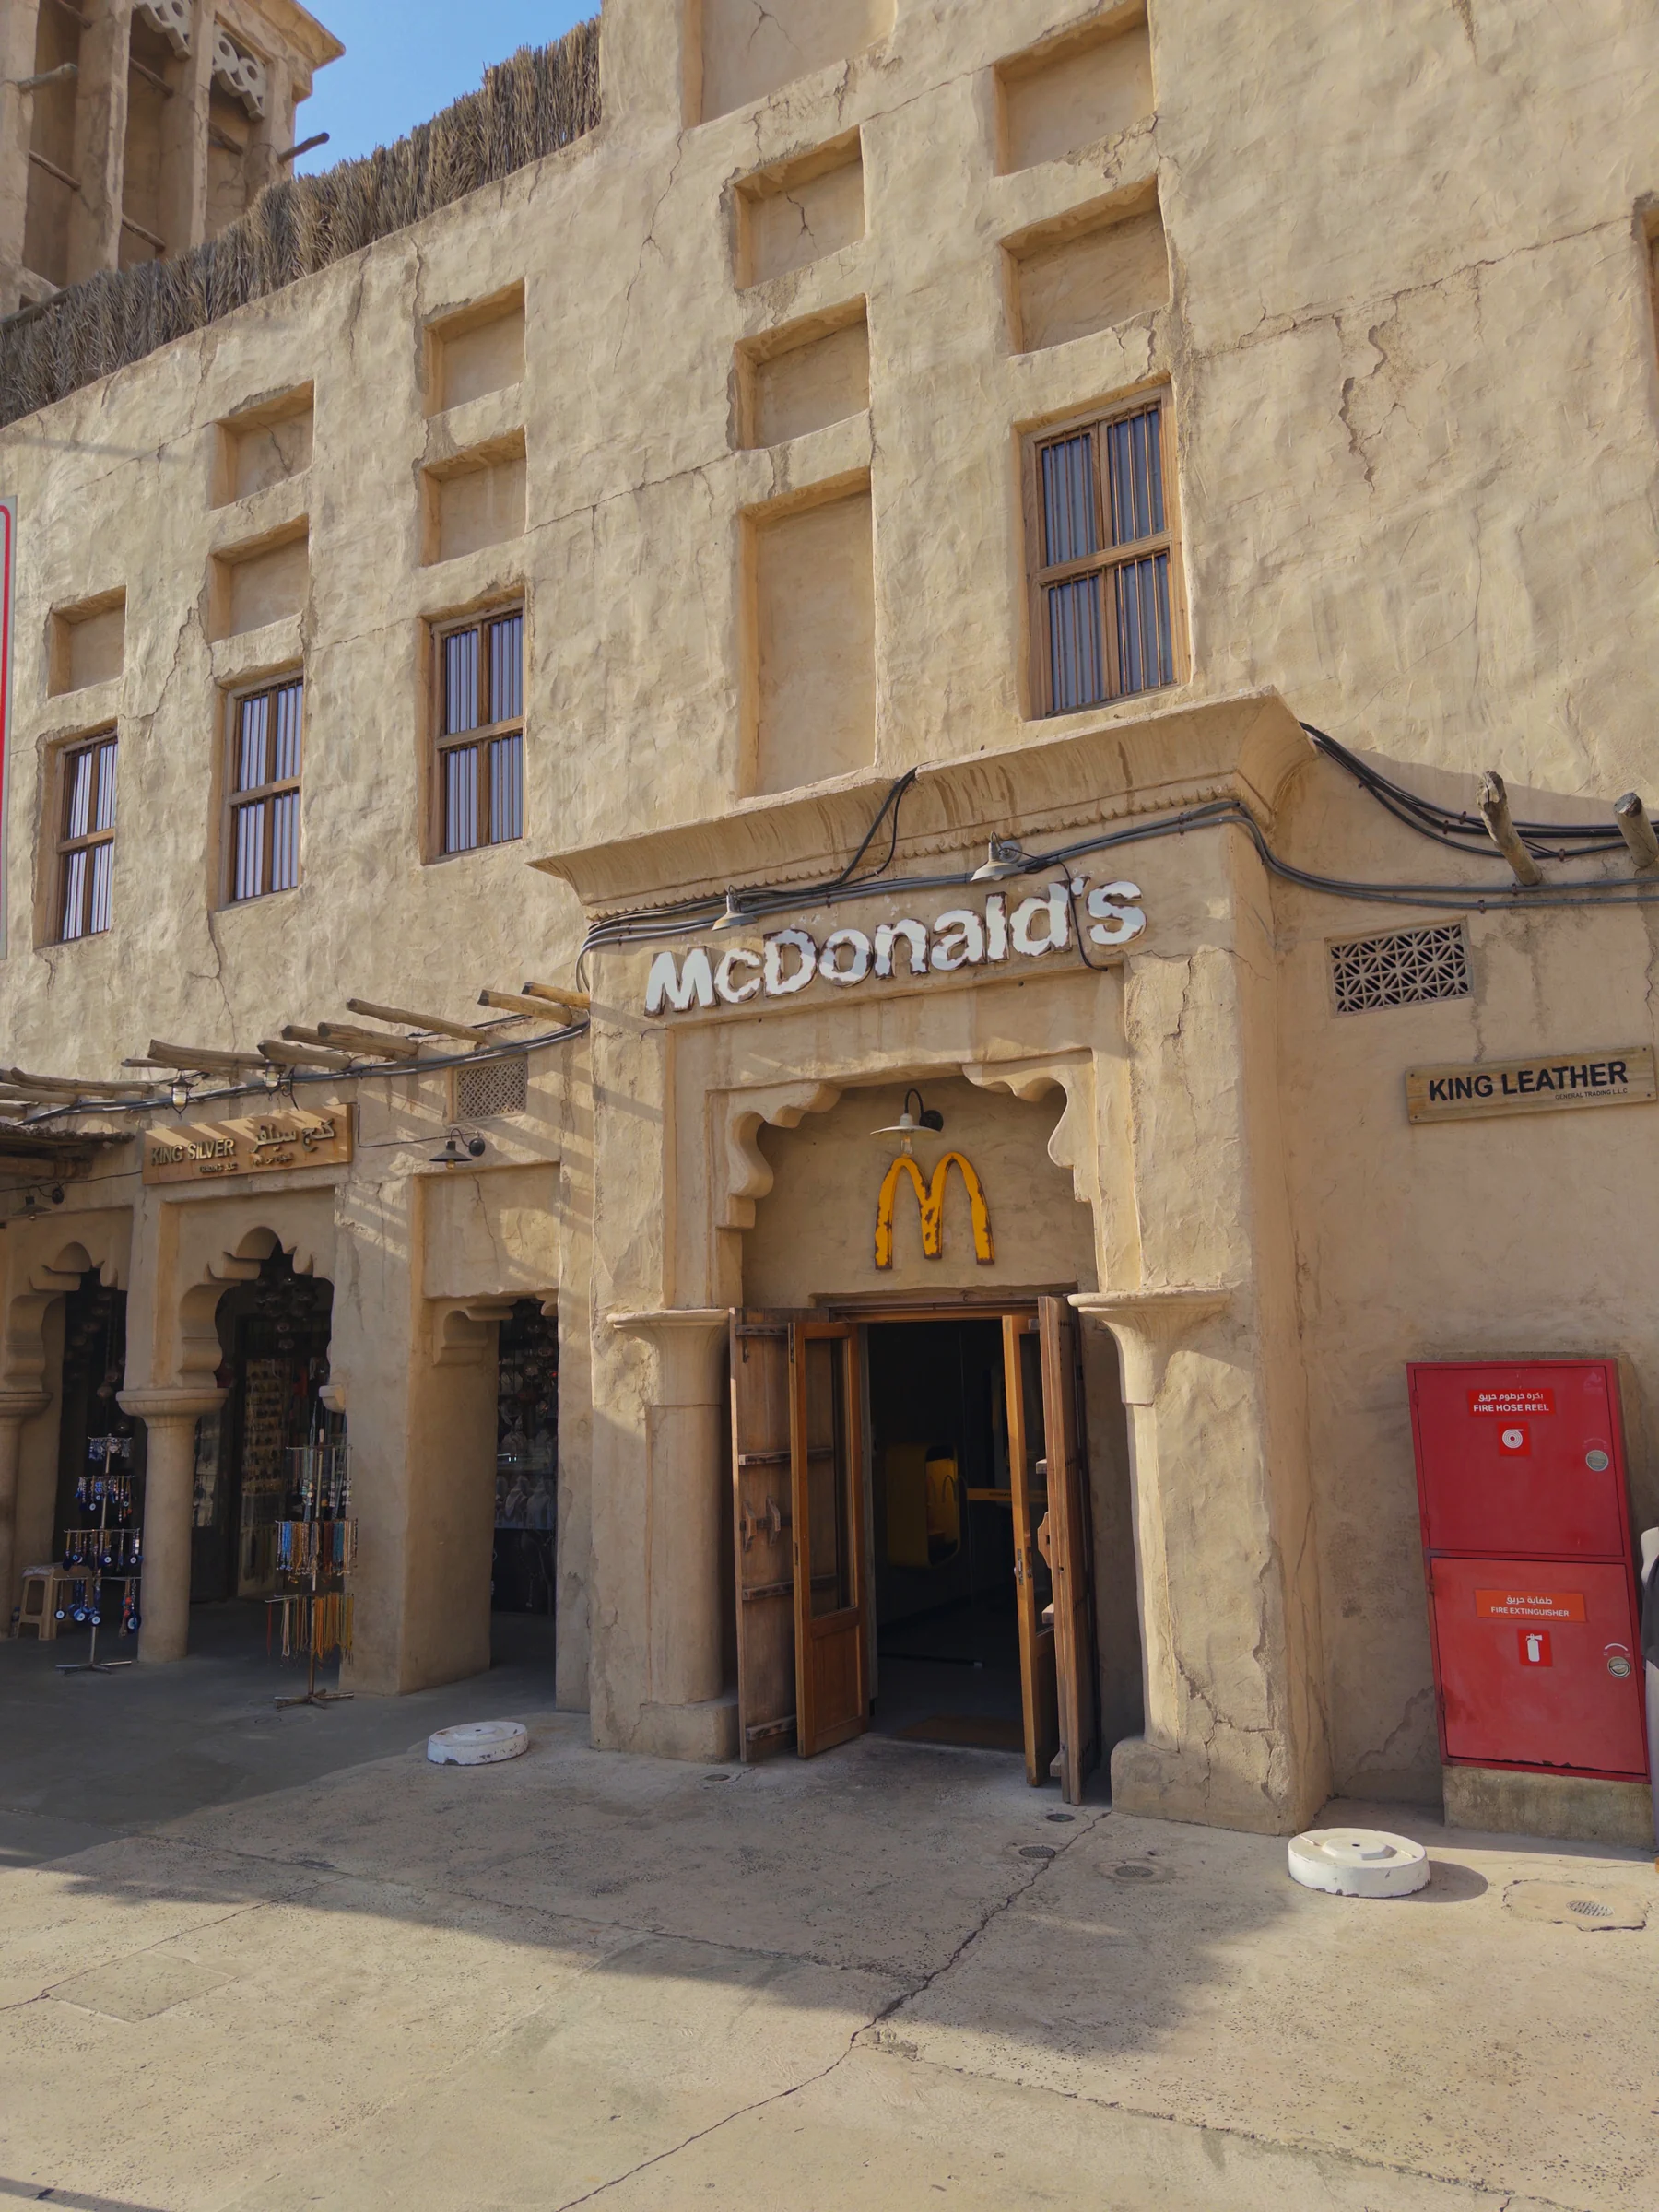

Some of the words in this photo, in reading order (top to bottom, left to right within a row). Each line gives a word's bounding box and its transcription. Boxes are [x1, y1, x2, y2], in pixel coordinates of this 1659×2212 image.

[644, 875, 1148, 1016] McDonald's
[1430, 1075, 1493, 1101] KING
[1501, 1061, 1629, 1095] LEATHER
[1555, 1091, 1583, 1100] GENERAL
[1584, 1088, 1612, 1098] TRADING
[151, 1143, 184, 1166] KING
[187, 1138, 237, 1160] SILVER
[1478, 1393, 1498, 1402] حريق
[1499, 1392, 1525, 1402] خرطوم
[1526, 1392, 1544, 1401] بكرة
[1473, 1404, 1494, 1412] FIRE
[1496, 1404, 1524, 1412] HOSE
[1525, 1403, 1549, 1411] REEL
[1505, 1594, 1525, 1606] حريق
[1526, 1595, 1553, 1606] طفاية
[1510, 1607, 1570, 1617] EXTINGUISHER
